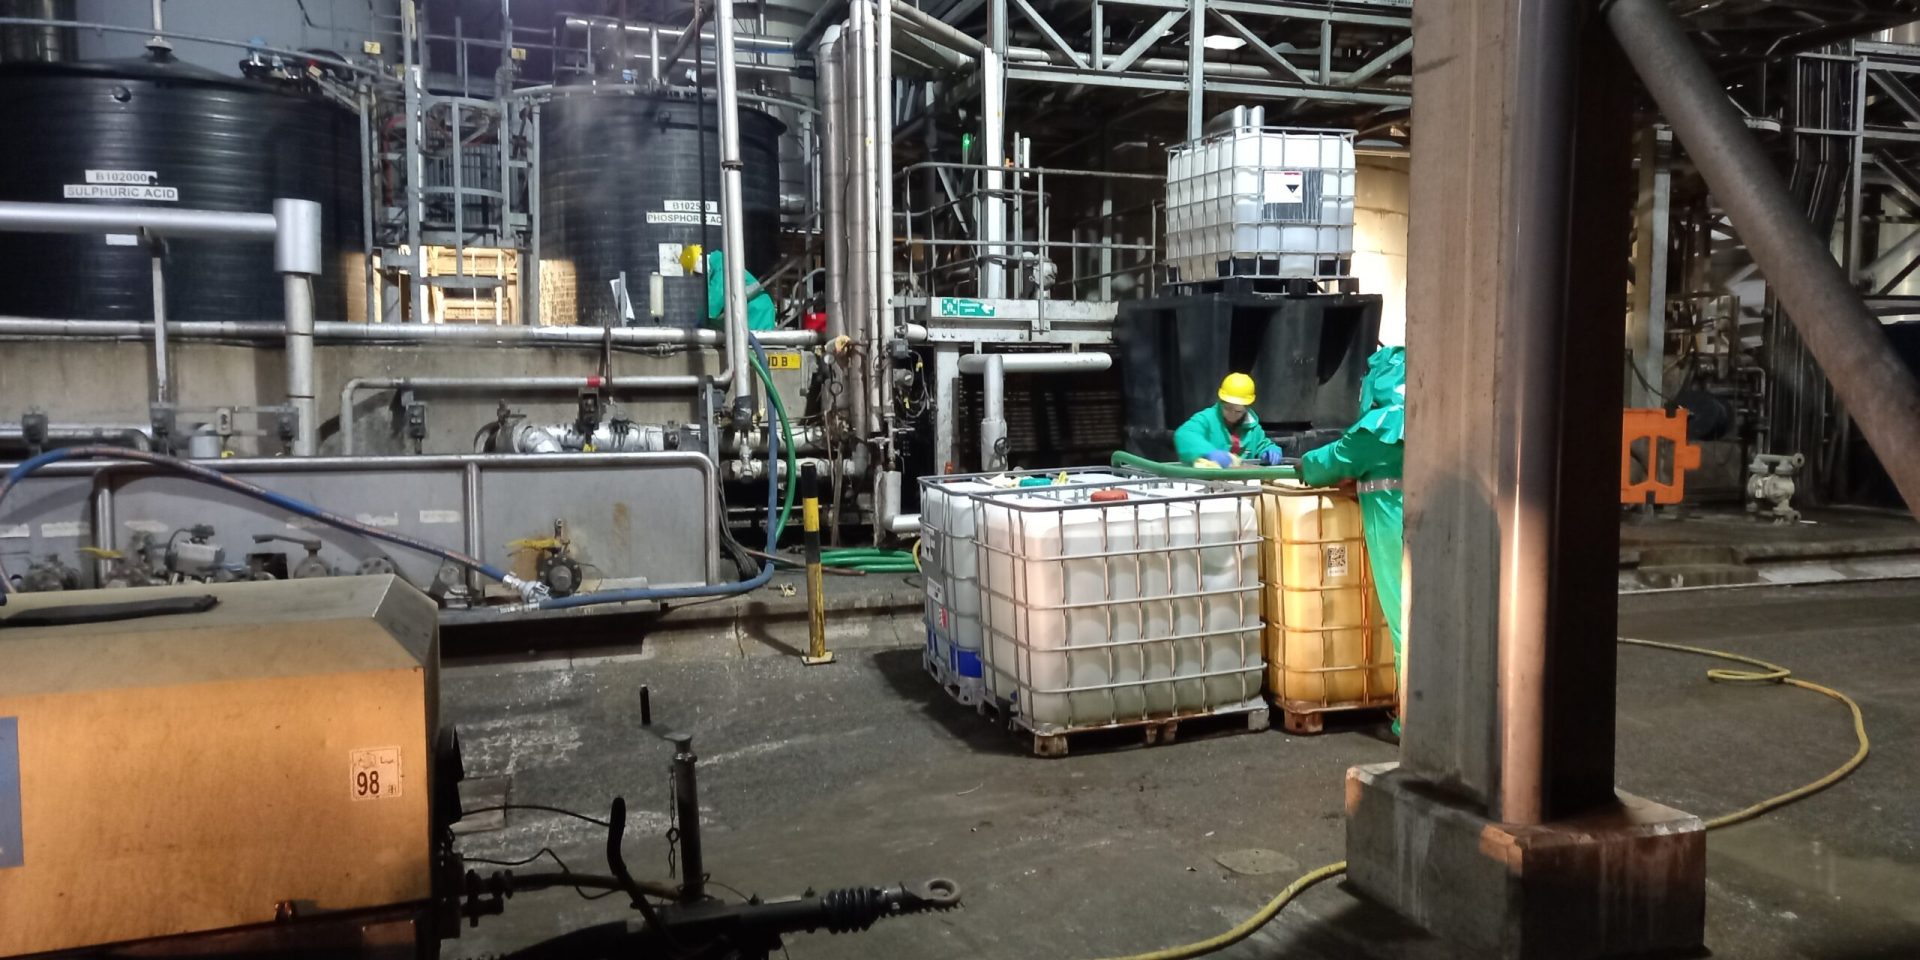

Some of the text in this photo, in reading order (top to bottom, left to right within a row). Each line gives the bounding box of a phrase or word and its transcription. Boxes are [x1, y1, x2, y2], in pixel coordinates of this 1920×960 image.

[95, 172, 148, 182] B102000
[67, 186, 175, 199] SULPHURIC ACID
[673, 202, 711, 211] B10250
[647, 214, 708, 223] PHOSPHOR
[781, 356, 788, 367] B
[357, 770, 380, 796] 98
